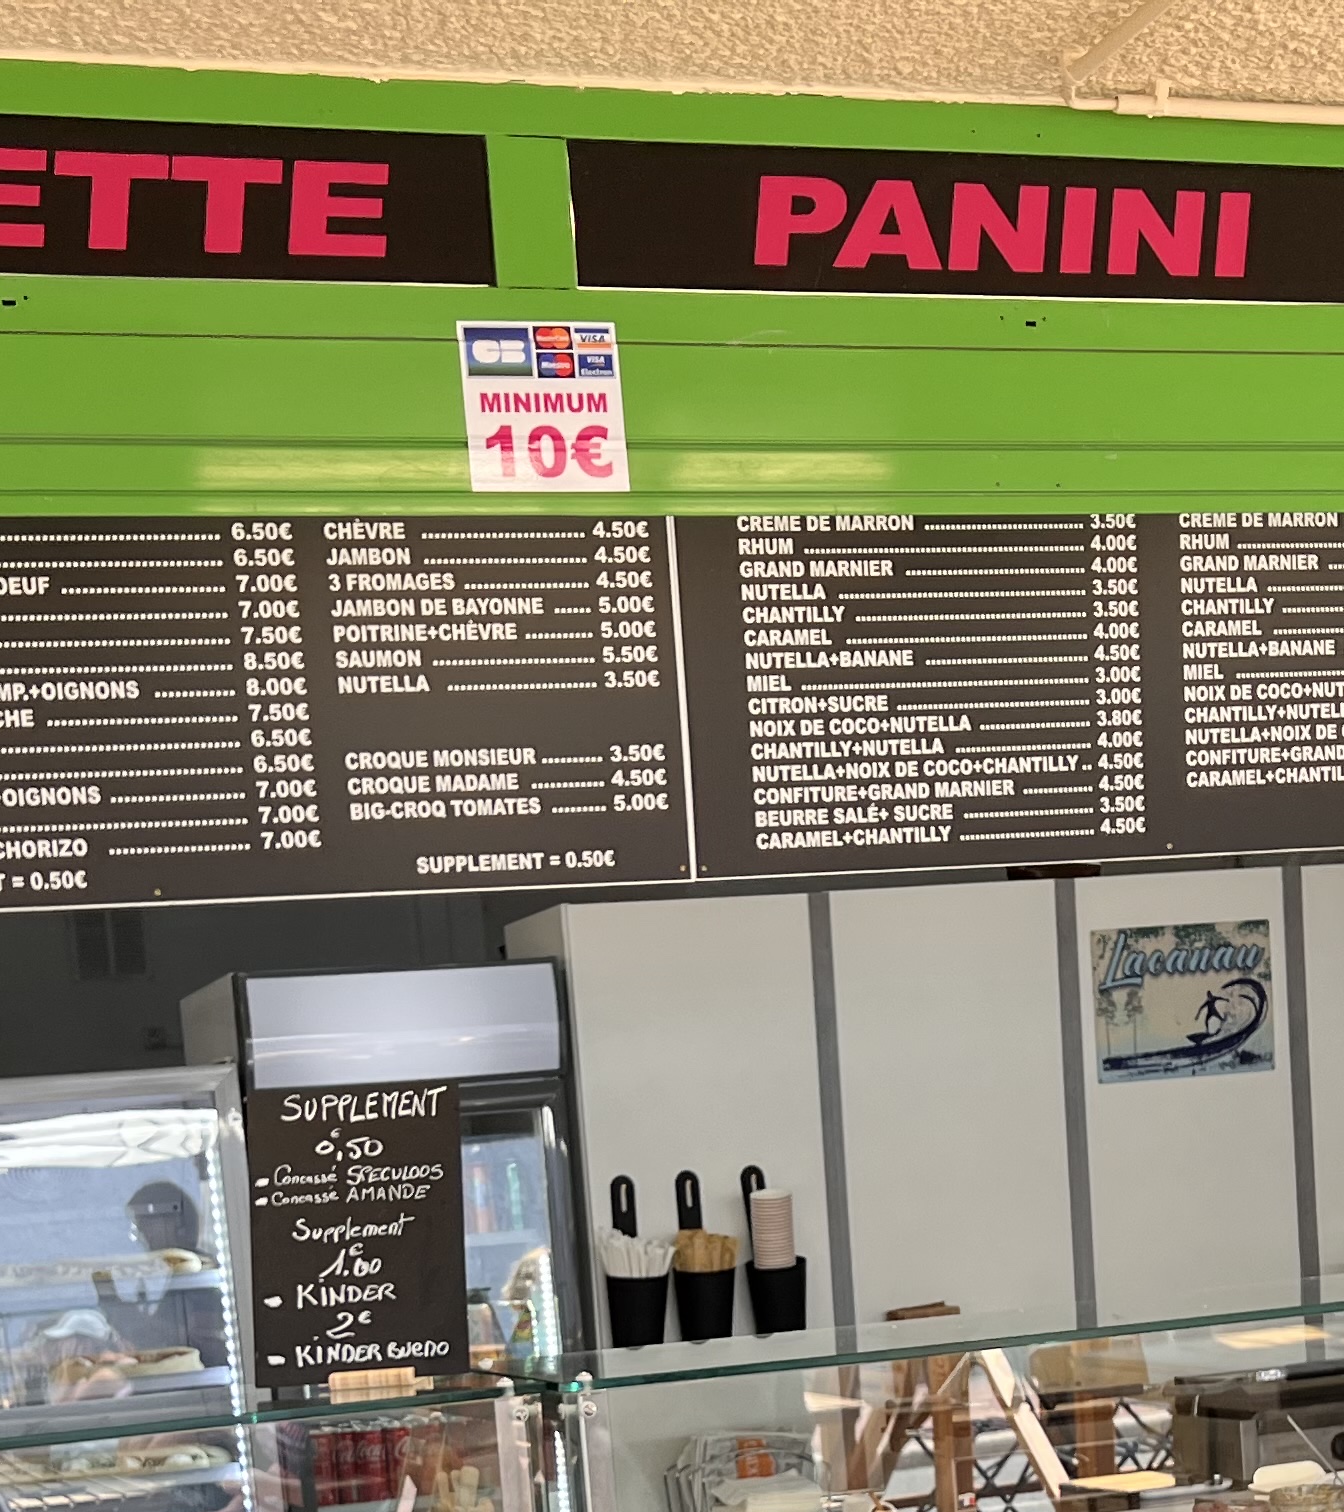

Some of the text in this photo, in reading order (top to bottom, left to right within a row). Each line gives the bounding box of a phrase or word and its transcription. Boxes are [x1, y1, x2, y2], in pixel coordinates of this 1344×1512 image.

[754, 175, 1251, 278] PANINI
[480, 393, 607, 413] MINIMUM
[486, 425, 613, 478] 10€
[232, 523, 292, 540] 6.50€
[324, 518, 649, 540] CHÈVRE 4.50€
[739, 535, 1136, 555] RHUM 4.00€
[1180, 534, 1229, 549] RHUM
[234, 549, 295, 566] 6.50€
[327, 546, 650, 565] JAMBON 4.50€
[1180, 555, 1239, 572] GRAND
[1244, 554, 1318, 570] MARNIER
[740, 557, 1137, 578] GRAND MARNIER 4.00€
[329, 571, 652, 591] 3 FROMAGES 4.50€
[1181, 577, 1257, 593] NUTELLA
[238, 600, 299, 618] 7.00€
[331, 596, 654, 617] JAMBON DE BAYONNE 5.00€
[743, 601, 1139, 623] CHANTILLY 3.50€
[744, 622, 1139, 646] CARAMEL 4.00€
[336, 646, 658, 668] SAUMON 5.50€
[246, 677, 307, 696] 8.00€
[338, 670, 660, 694] NUTELLA 3.50€
[747, 666, 1140, 692] MIEL 3.00€
[251, 728, 312, 747] 6.50€
[254, 754, 314, 773] 6.50€
[345, 744, 665, 770] CROQUE MONSIEUR 3.50€
[752, 752, 1143, 782] NUTELLA+NOIX DE COCO+CHANTILLY 4.50€
[258, 805, 319, 824] 7.00€
[261, 830, 321, 849] 7.00€
[30, 870, 87, 890] 0.50€
[281, 1086, 447, 1123] SUPPLEMENT
[346, 1184, 430, 1203] AMANDE
